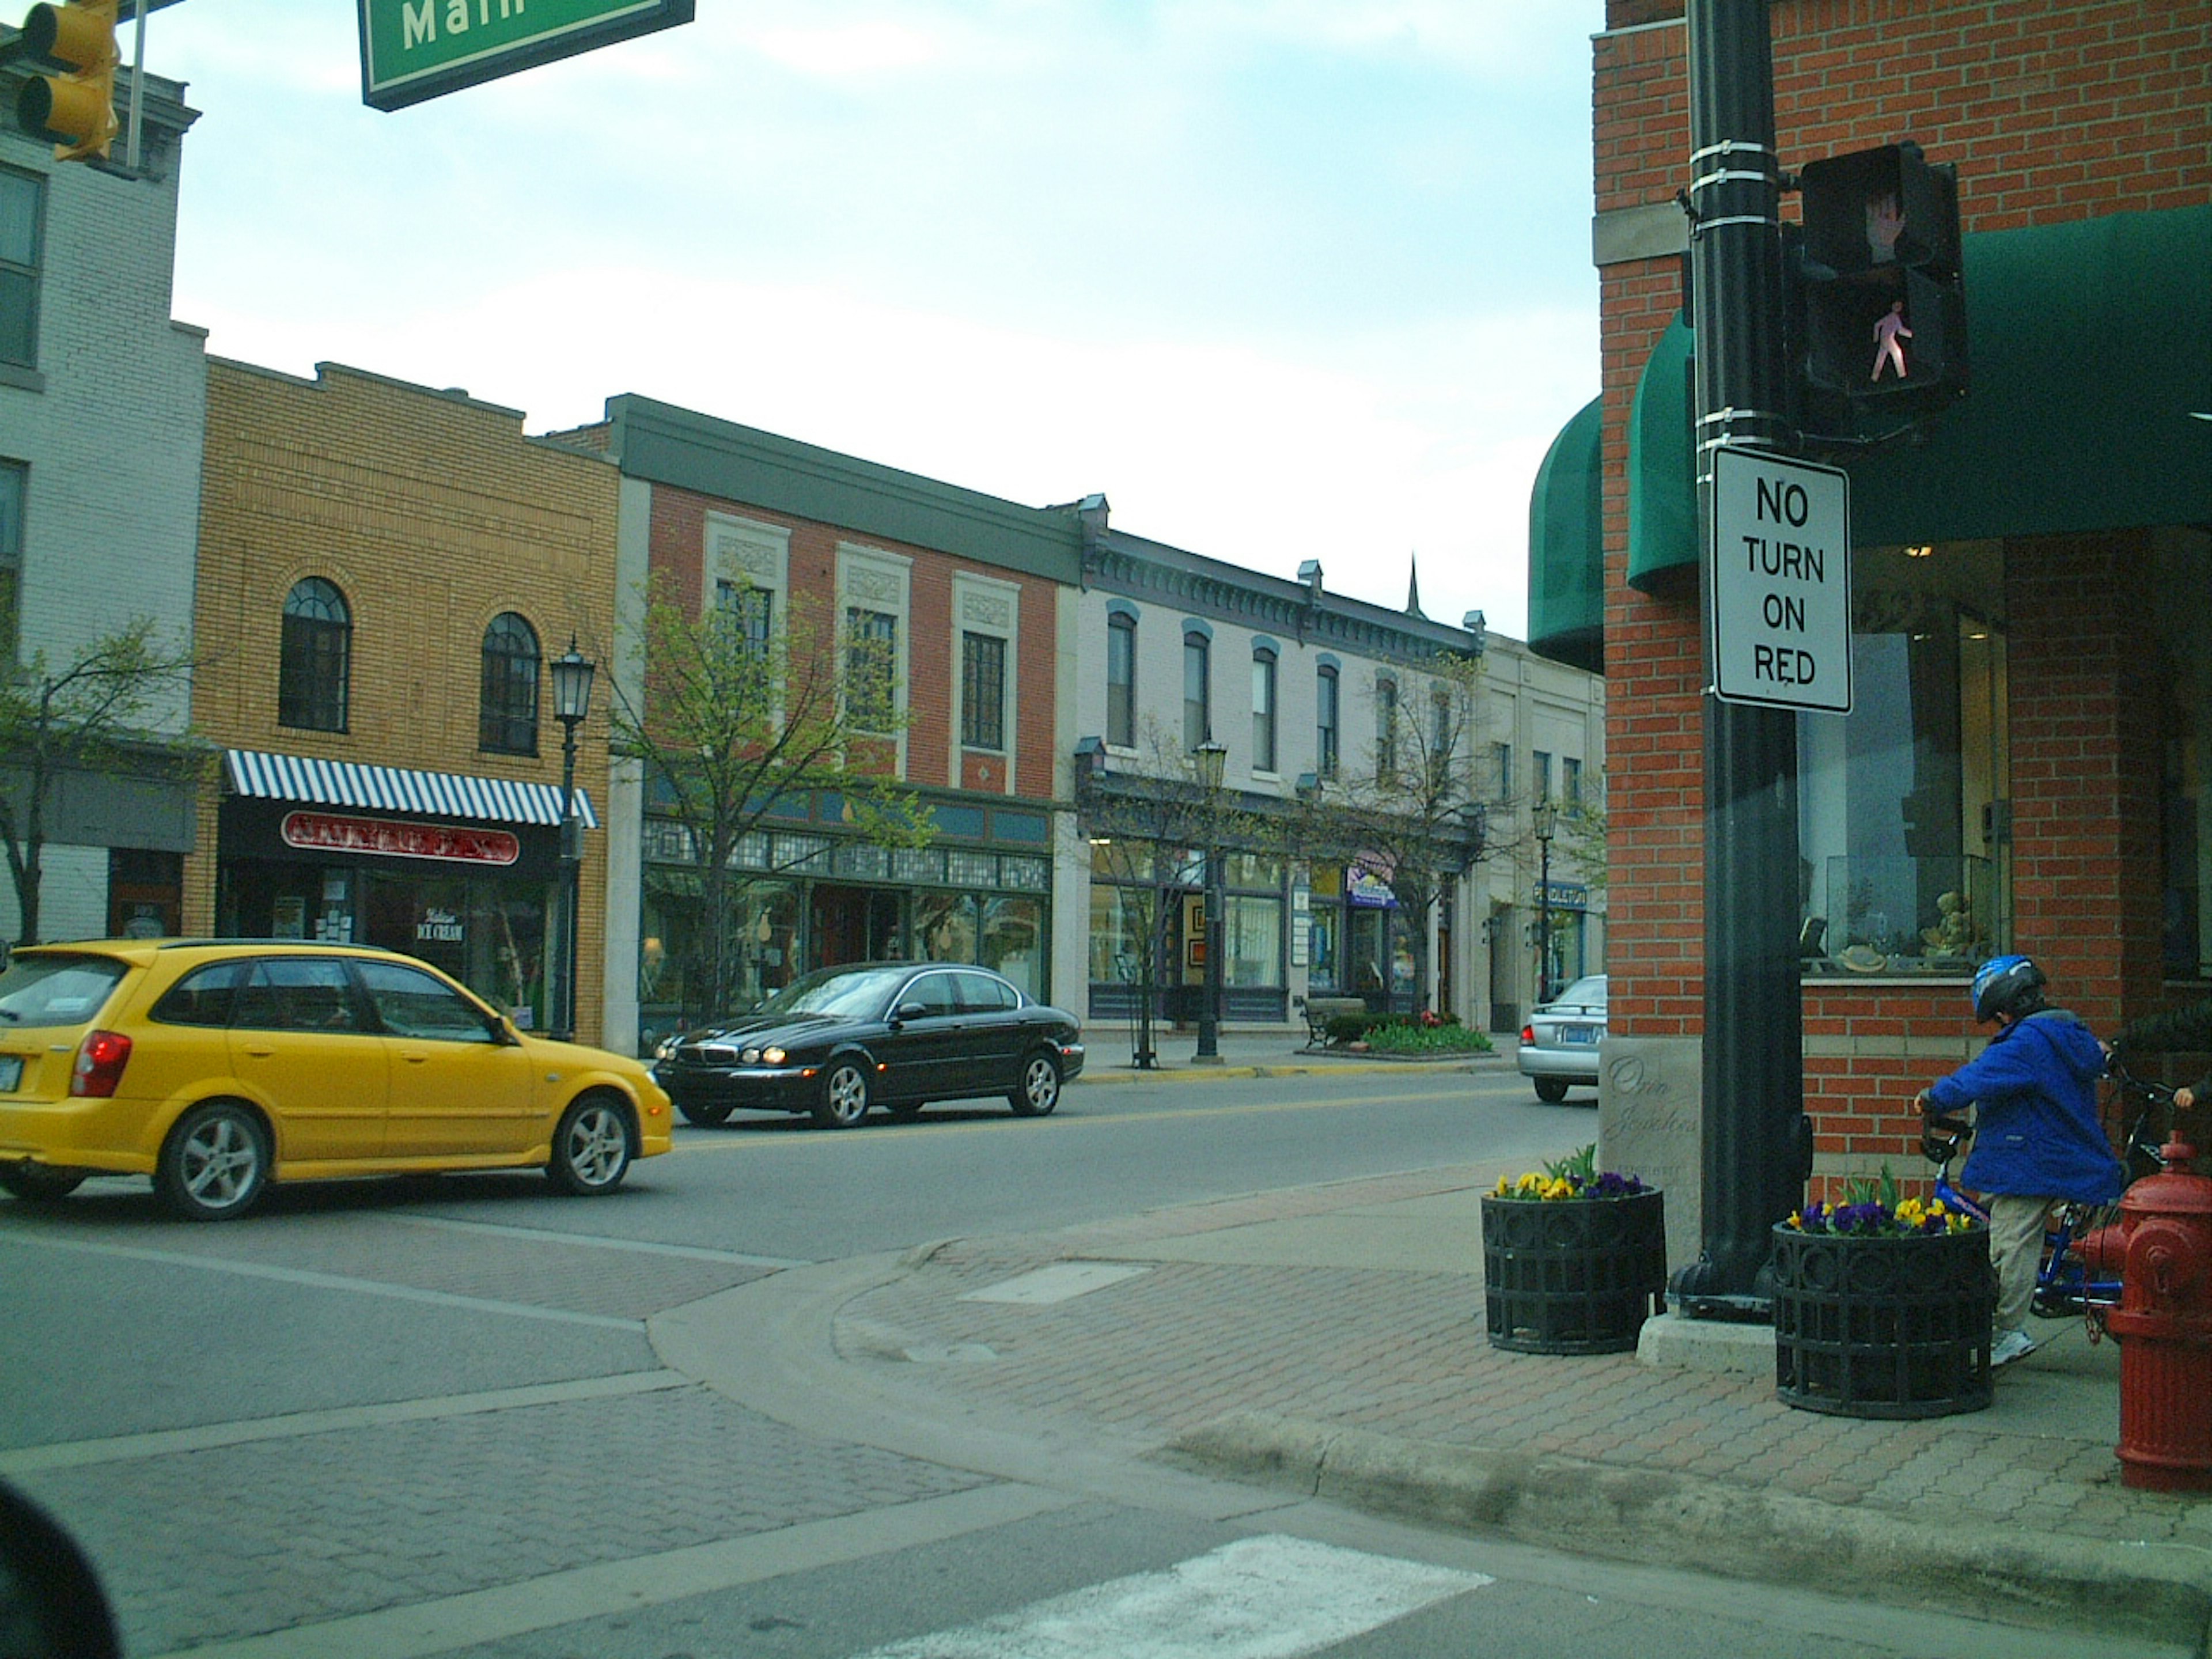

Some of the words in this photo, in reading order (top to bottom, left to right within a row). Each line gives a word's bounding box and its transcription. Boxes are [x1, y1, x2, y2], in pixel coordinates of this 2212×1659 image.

[1757, 477, 1808, 527] NO
[1743, 536, 1824, 582] TURN
[1763, 594, 1805, 632] ON
[1755, 645, 1815, 684] RED
